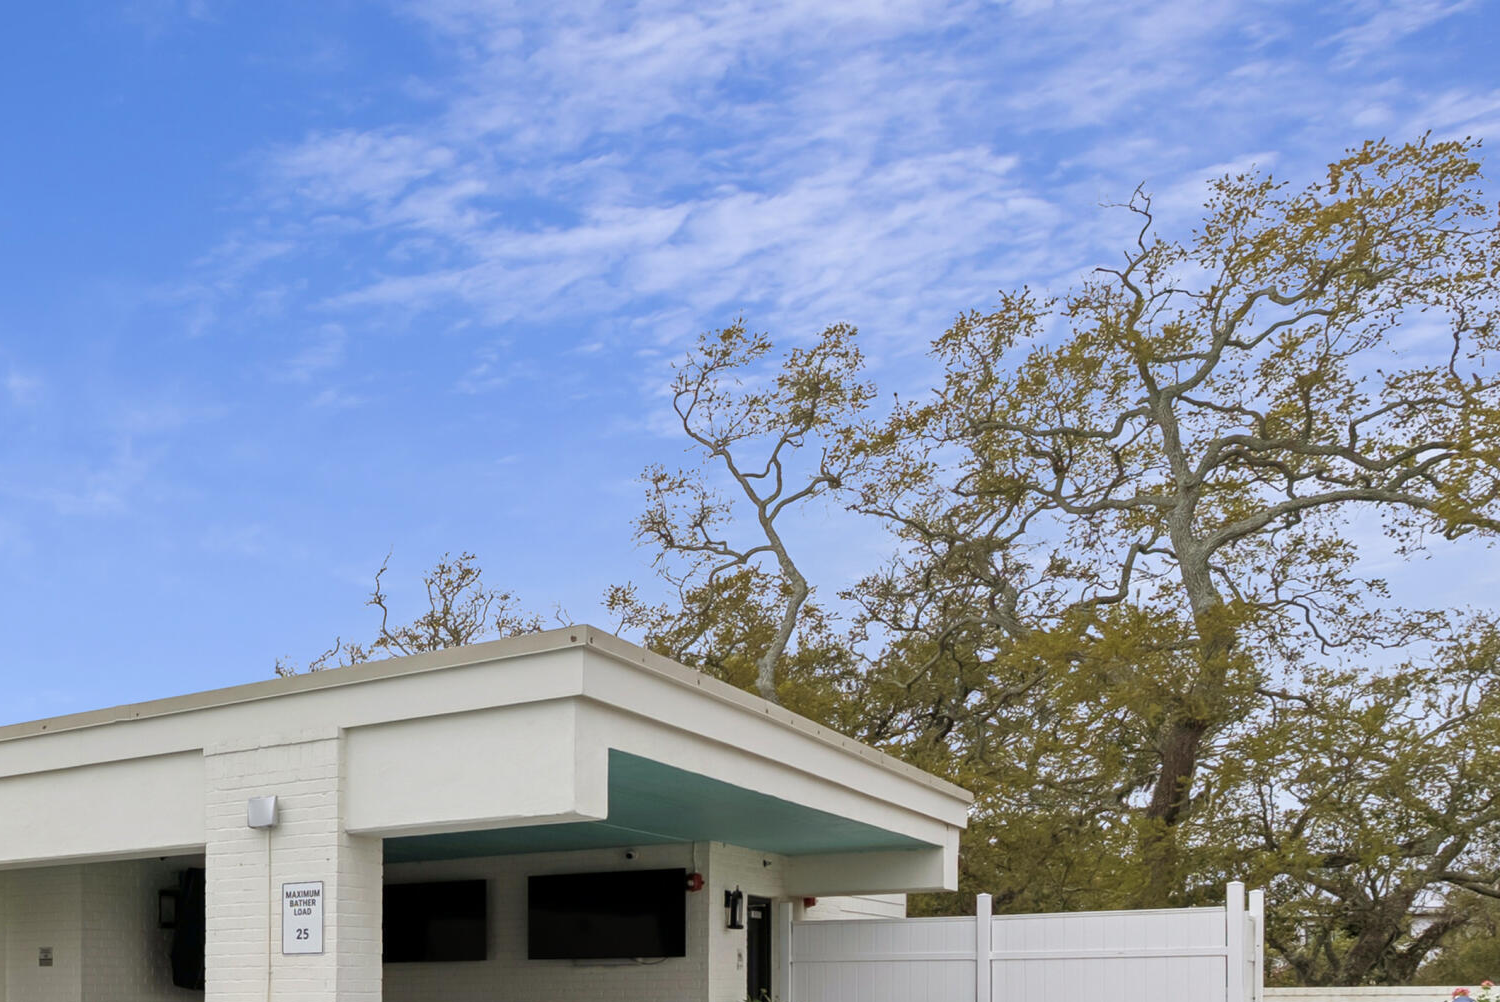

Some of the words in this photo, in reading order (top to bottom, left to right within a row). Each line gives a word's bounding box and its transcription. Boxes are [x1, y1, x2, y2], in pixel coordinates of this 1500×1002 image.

[285, 889, 320, 899] MAXIMUM
[289, 899, 316, 908] BATHER
[293, 908, 312, 916] LOAD
[296, 928, 310, 940] 25
